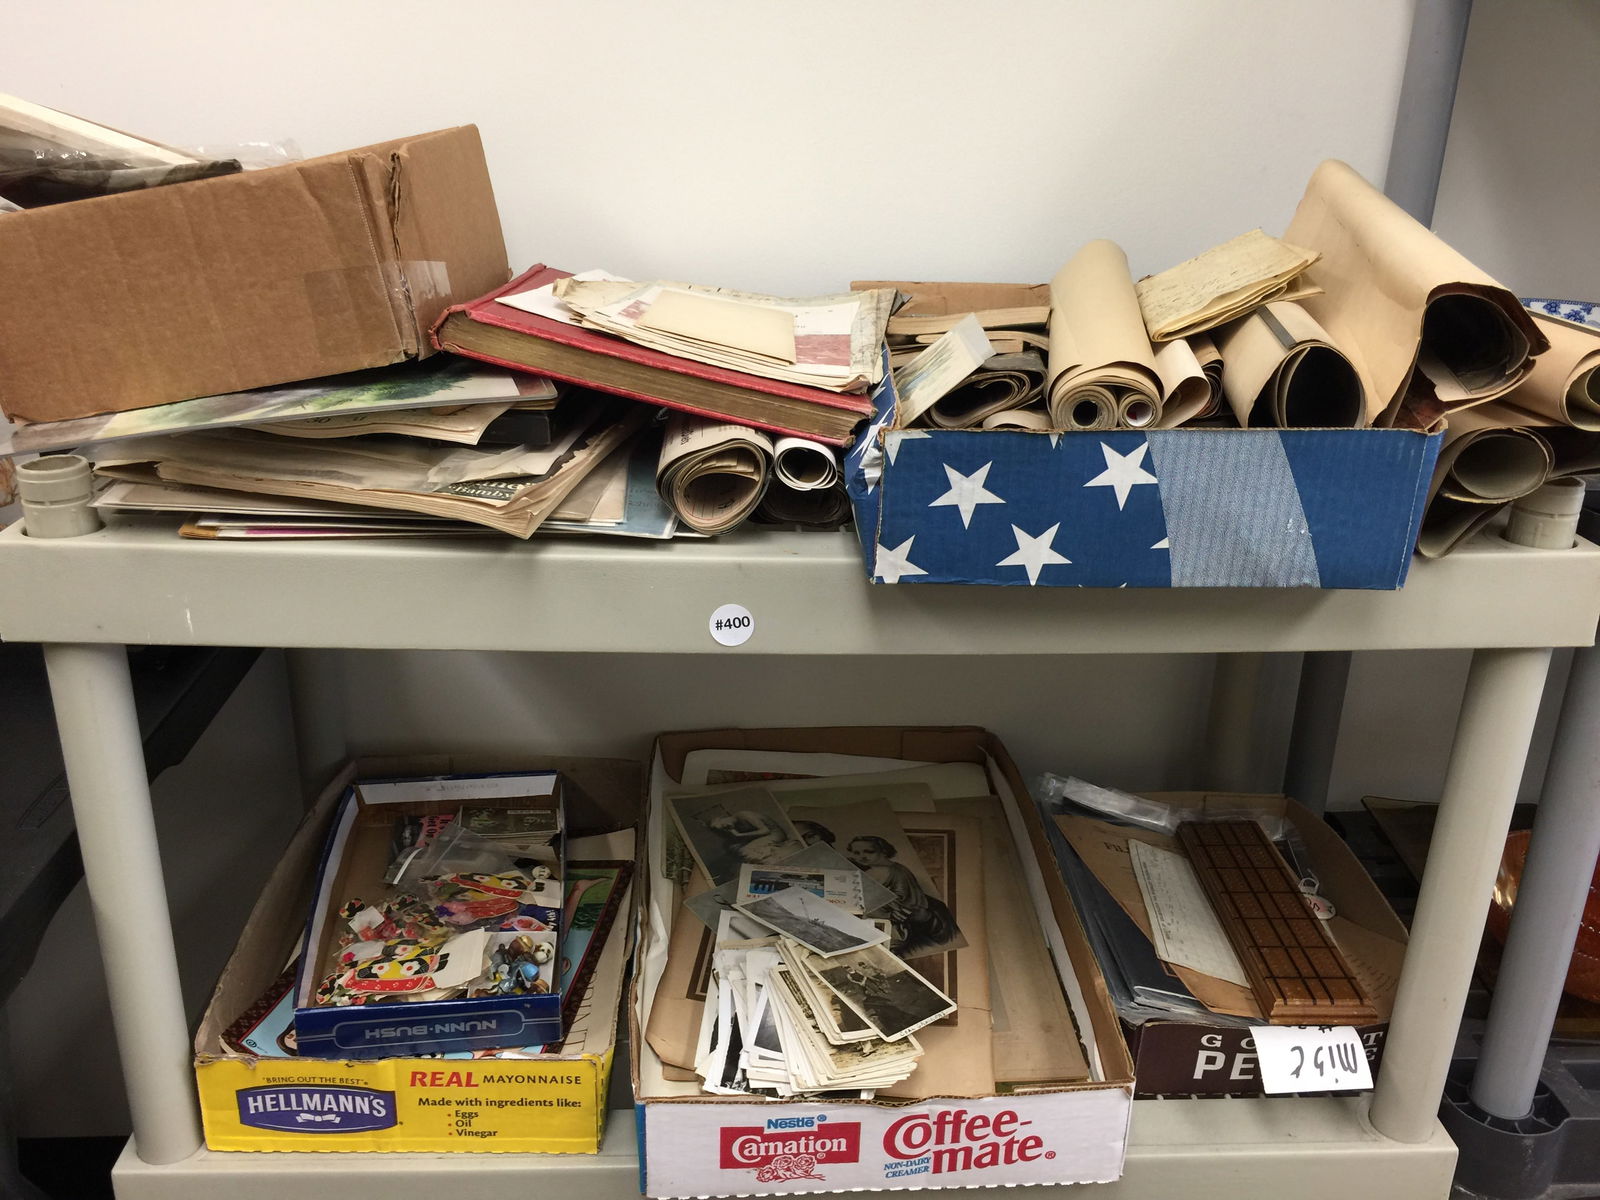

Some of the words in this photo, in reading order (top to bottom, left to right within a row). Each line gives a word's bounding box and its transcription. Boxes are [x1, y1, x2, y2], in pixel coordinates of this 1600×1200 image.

[715, 616, 750, 630] #400
[409, 1071, 479, 1088] REAL
[482, 1074, 582, 1085] MAYONNAISE
[247, 1093, 387, 1118] HELLMANN'S
[418, 1097, 452, 1107] Made
[455, 1097, 482, 1107] with
[485, 1098, 554, 1109] ingredients
[556, 1098, 582, 1108] like:
[455, 1109, 479, 1120] Eggs
[455, 1119, 472, 1128] Oil
[456, 1128, 498, 1138] Vinegar
[731, 1135, 848, 1164] Carnation
[883, 1156, 932, 1171] NON-DAIRY
[885, 1165, 931, 1179] CREAMER
